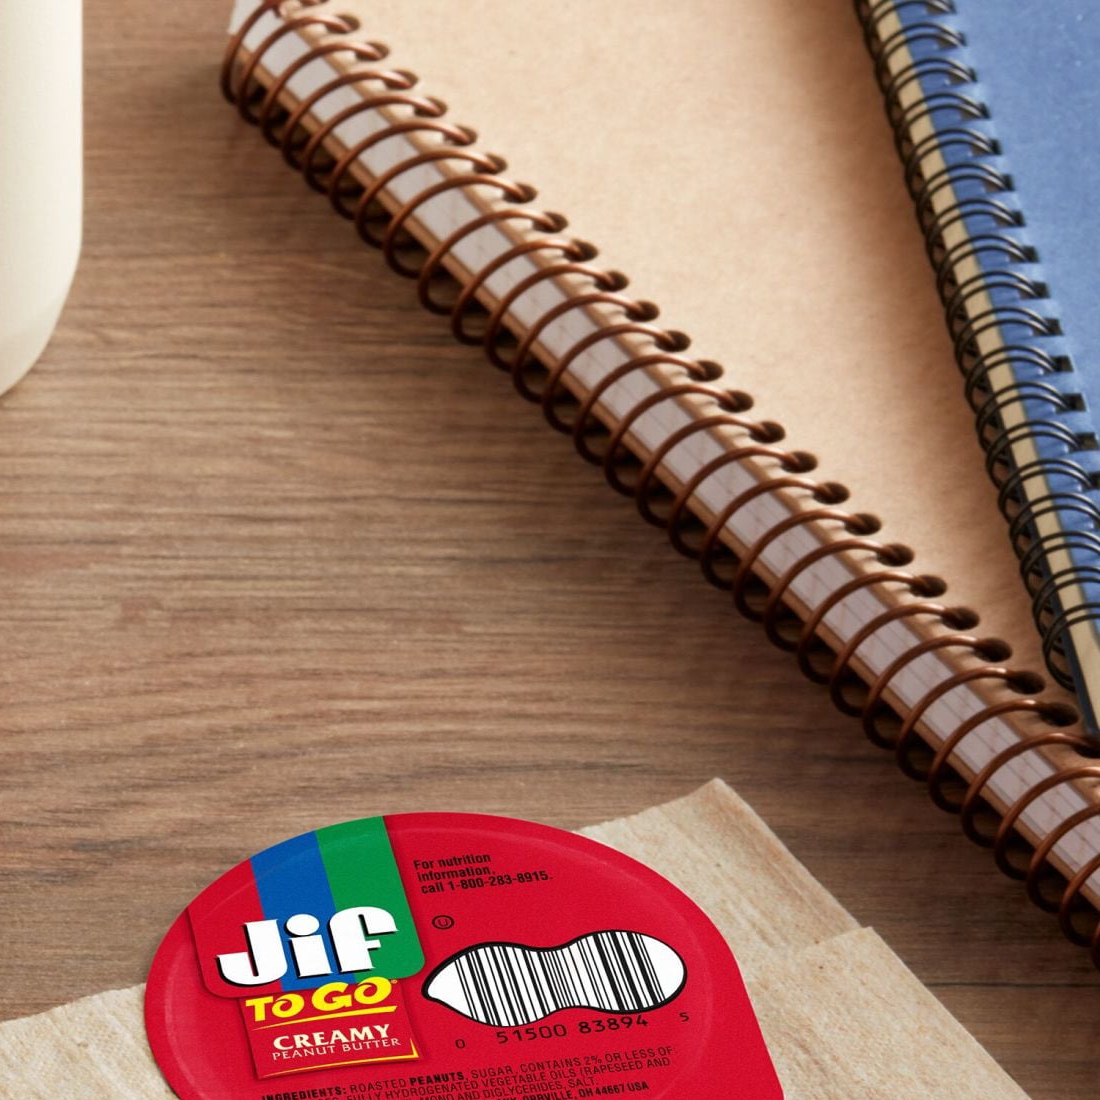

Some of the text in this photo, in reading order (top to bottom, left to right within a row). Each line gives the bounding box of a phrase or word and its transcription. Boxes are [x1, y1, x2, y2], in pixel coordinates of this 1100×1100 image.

[413, 854, 491, 870] For nutrition
[420, 883, 444, 894] call
[216, 906, 399, 987] Jif
[245, 976, 392, 1022] TO GO
[273, 1024, 390, 1051] CREAMY
[455, 1012, 690, 1049] 0 51500 83894 5
[272, 1037, 401, 1061] PEANUT BUTTER
[349, 1079, 406, 1094] ROASTED
[520, 1056, 581, 1073] CONTAINS
[584, 1055, 602, 1066] 2%
[604, 1052, 622, 1063] OR
[625, 1048, 656, 1061] LESS
[385, 1080, 479, 1099] HYDROGENATED
[481, 1073, 546, 1089] VEGETABLE
[550, 1067, 577, 1081] OILS
[646, 1056, 671, 1068] AND
[457, 1091, 480, 1100] AND
[579, 1087, 594, 1098] OH
[595, 1083, 625, 1095] 44667
[626, 1081, 649, 1091] USA
